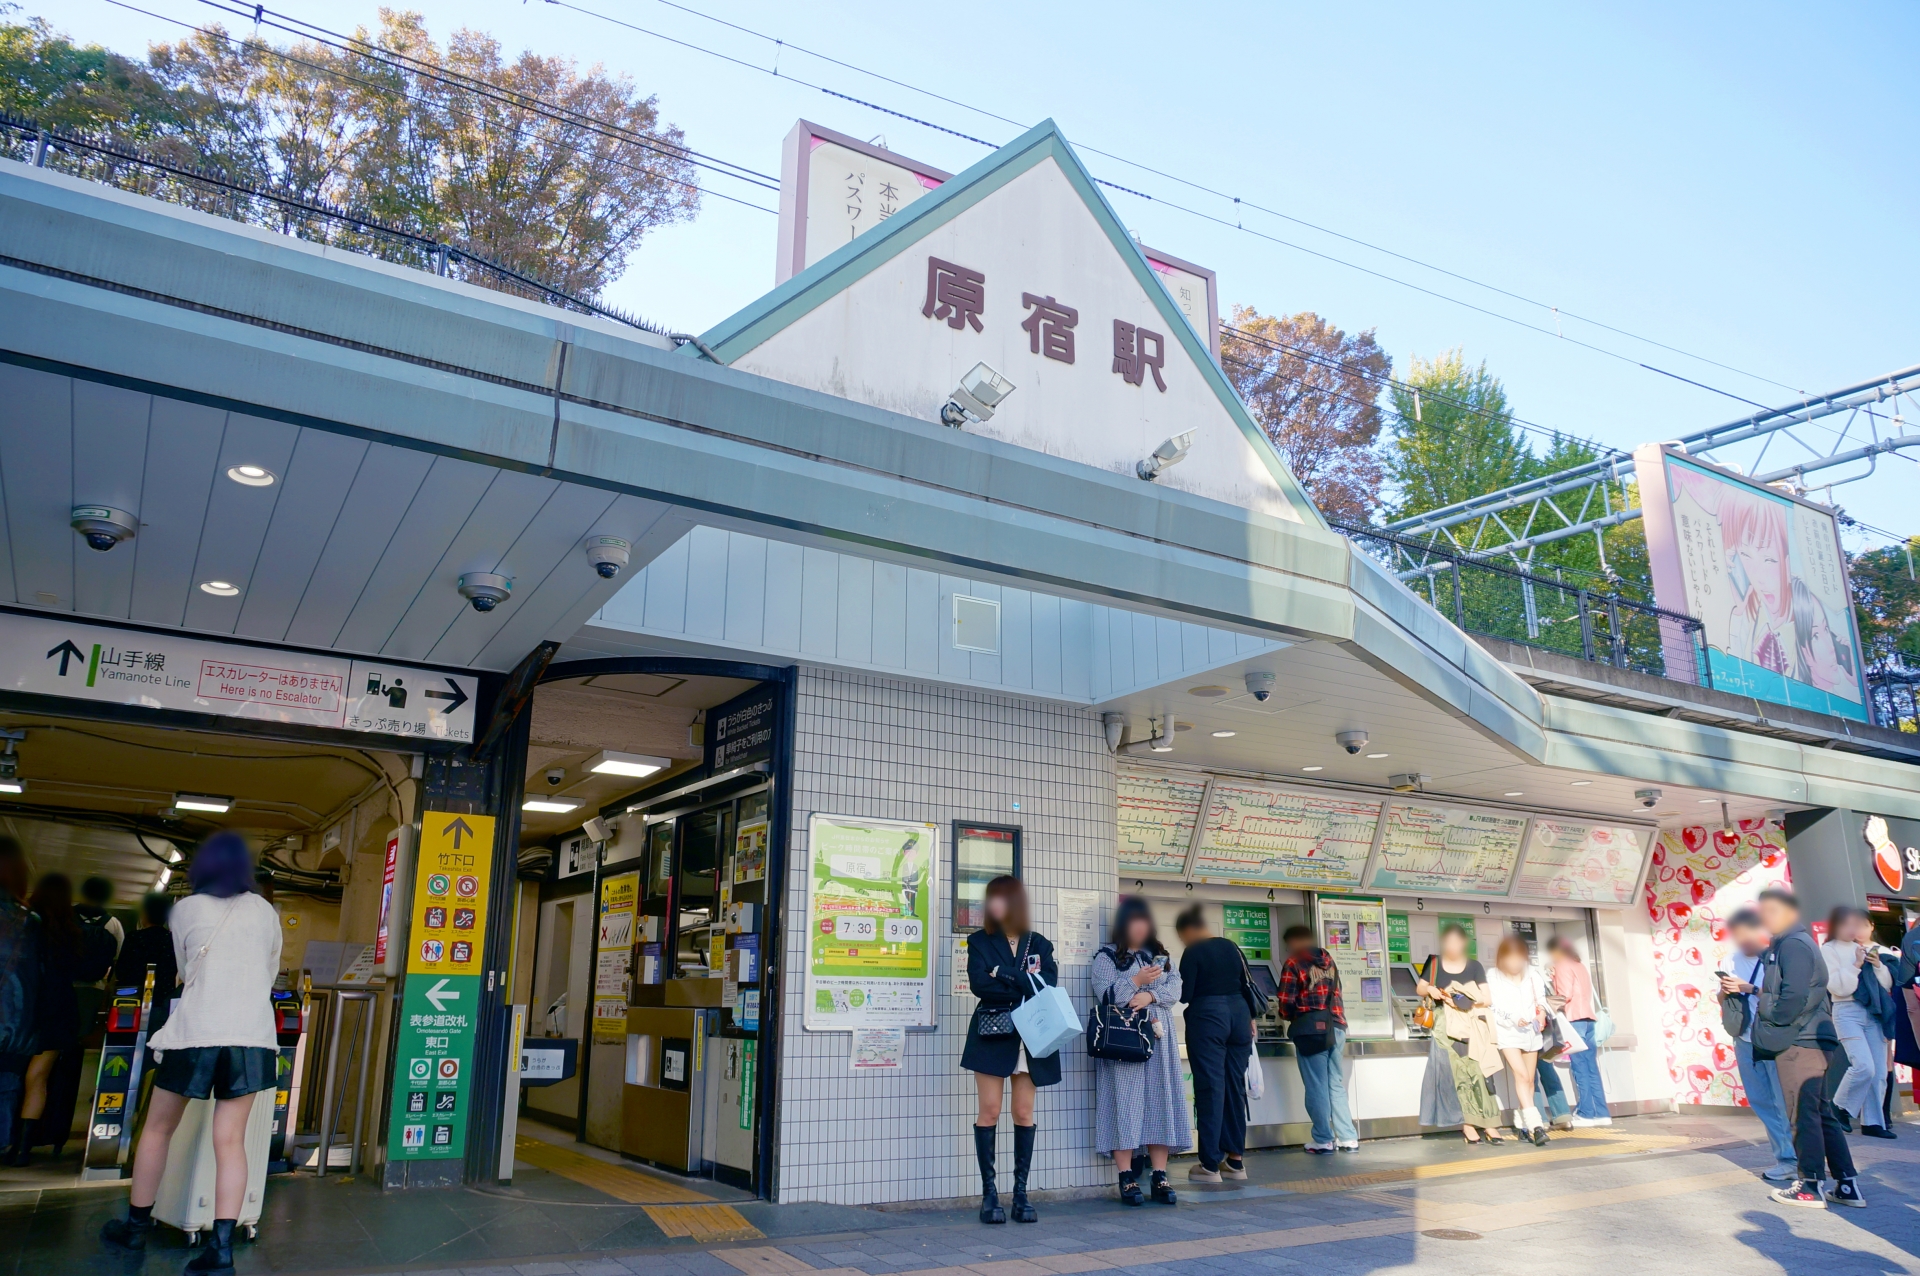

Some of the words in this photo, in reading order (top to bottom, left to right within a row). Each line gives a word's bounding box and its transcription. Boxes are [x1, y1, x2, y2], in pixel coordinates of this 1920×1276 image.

[922, 256, 1167, 392] 原宿駅
[101, 647, 166, 671] 山手線
[100, 668, 163, 684] Yamanote
[165, 675, 191, 689] Line
[205, 665, 340, 693] エスカレーターはありません
[220, 683, 246, 696] Here
[248, 685, 257, 697] is
[260, 688, 272, 699] no
[276, 689, 322, 704] Escalator
[349, 715, 426, 735] きっぷ売り場
[435, 725, 470, 739] Tickets
[438, 852, 475, 867] 竹下口
[846, 862, 866, 874] 原宿
[1267, 889, 1275, 902] 4
[1417, 898, 1424, 910] 5
[1484, 902, 1490, 914] 6
[1226, 909, 1244, 918] きっぷ
[1245, 910, 1267, 918] Tickets
[1322, 911, 1331, 919] How
[1334, 911, 1340, 919] to
[1342, 912, 1350, 920] buy
[1388, 918, 1407, 926] Tickets
[410, 1014, 468, 1027] 表参道改札
[425, 1036, 449, 1049] 東口
